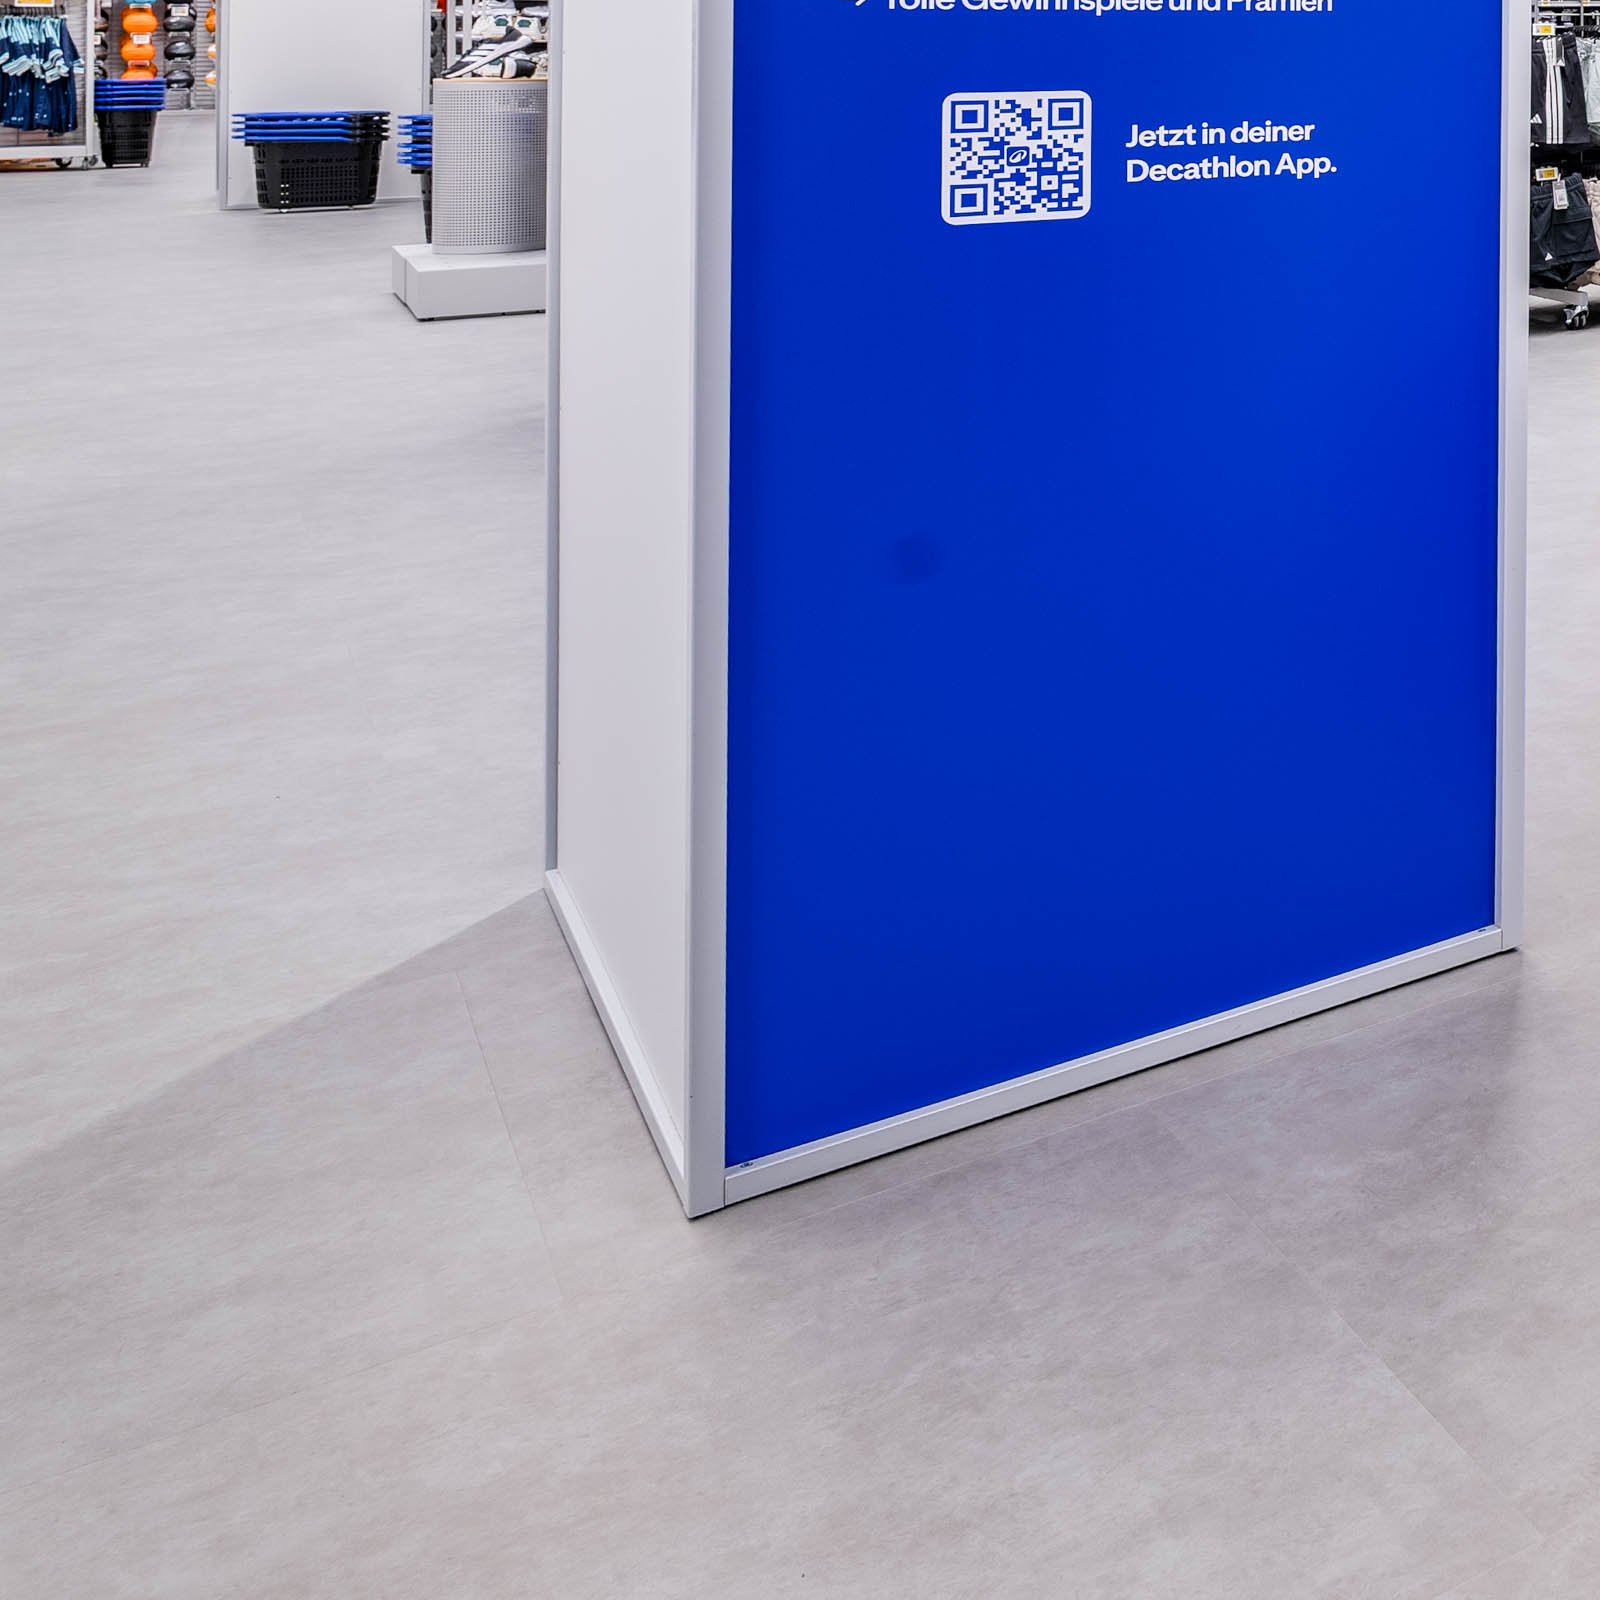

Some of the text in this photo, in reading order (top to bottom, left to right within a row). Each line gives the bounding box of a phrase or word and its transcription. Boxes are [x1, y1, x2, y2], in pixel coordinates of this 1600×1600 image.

[1125, 120, 1316, 148] Jetzt in deiner
[1126, 152, 1338, 183] Decathlon App.
